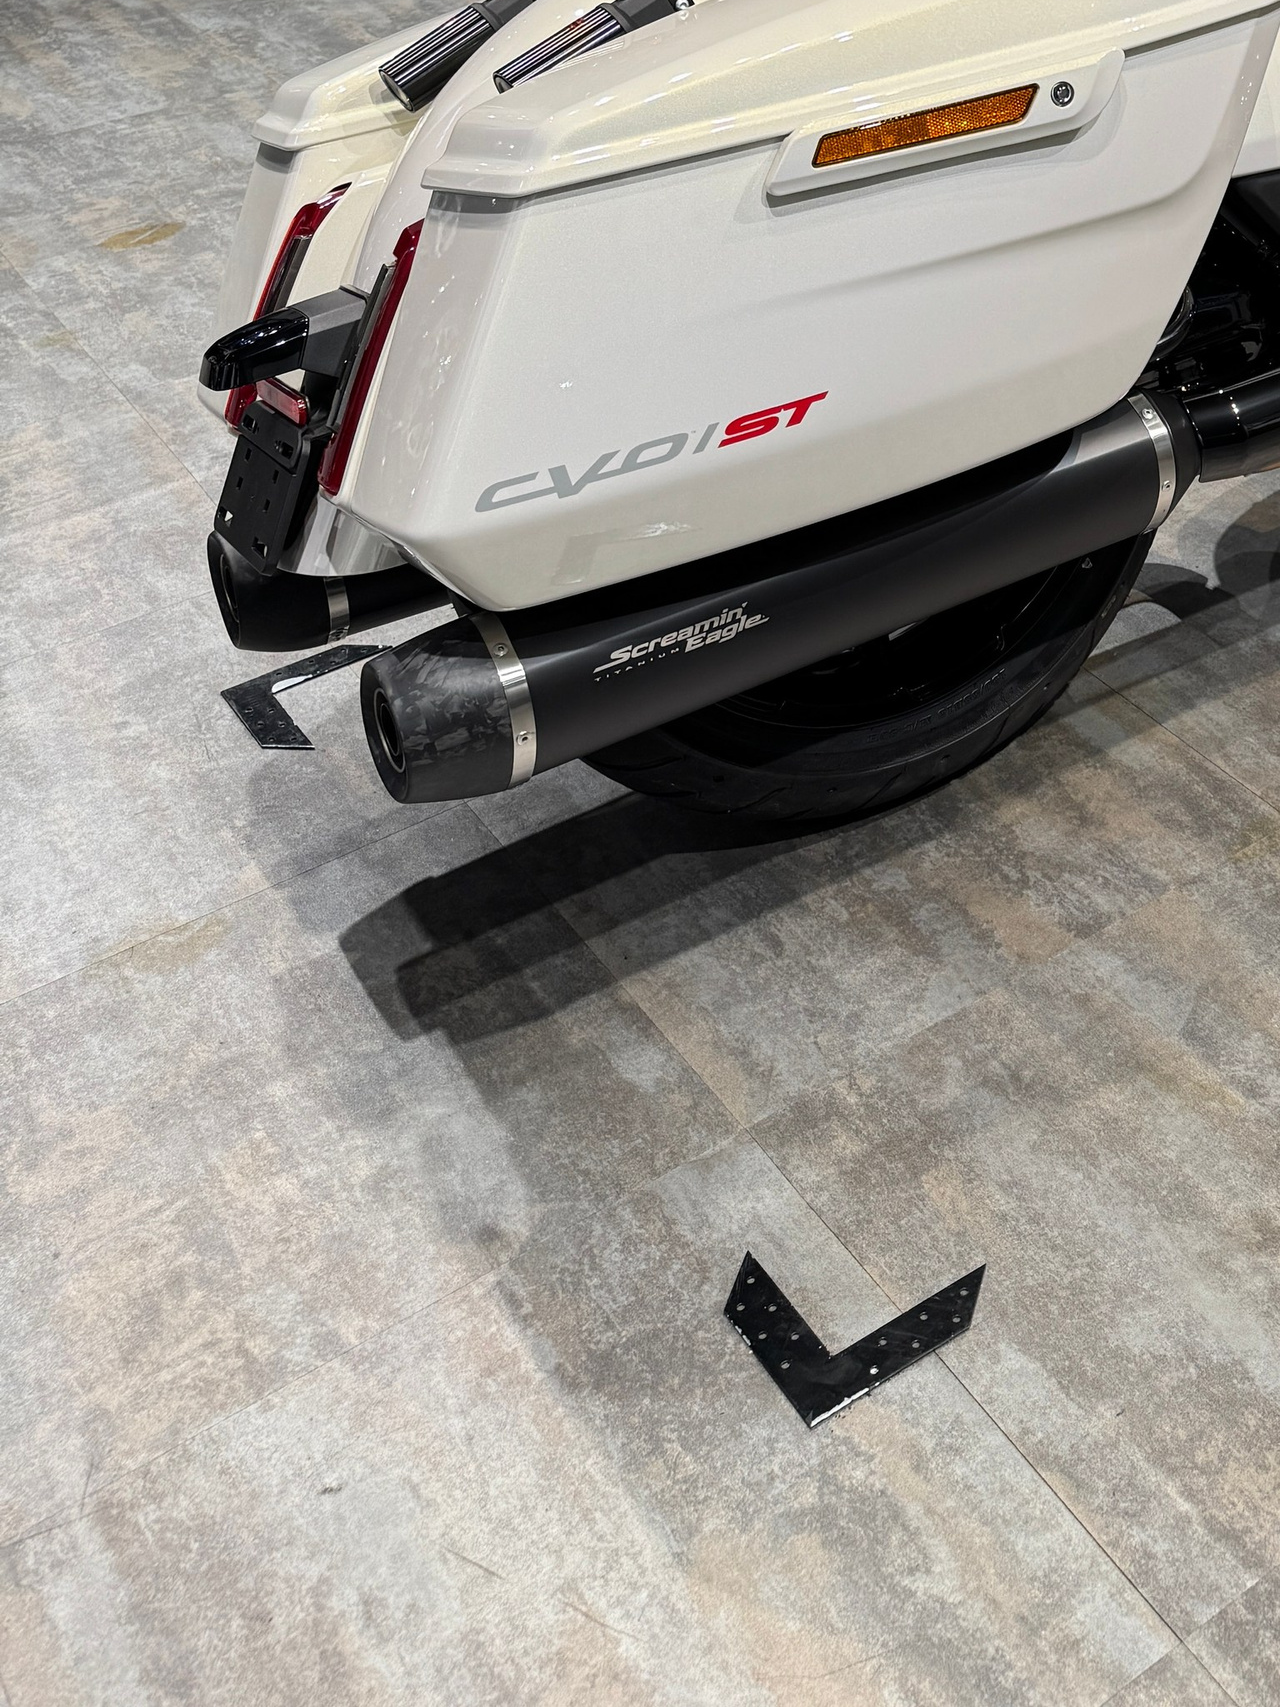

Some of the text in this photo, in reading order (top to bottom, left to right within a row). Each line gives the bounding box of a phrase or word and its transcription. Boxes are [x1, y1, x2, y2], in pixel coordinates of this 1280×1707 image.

[717, 390, 830, 449] ST
[592, 601, 749, 674] Screamin'
[684, 613, 770, 653] Eagle
[594, 647, 680, 682] TITANIUM
